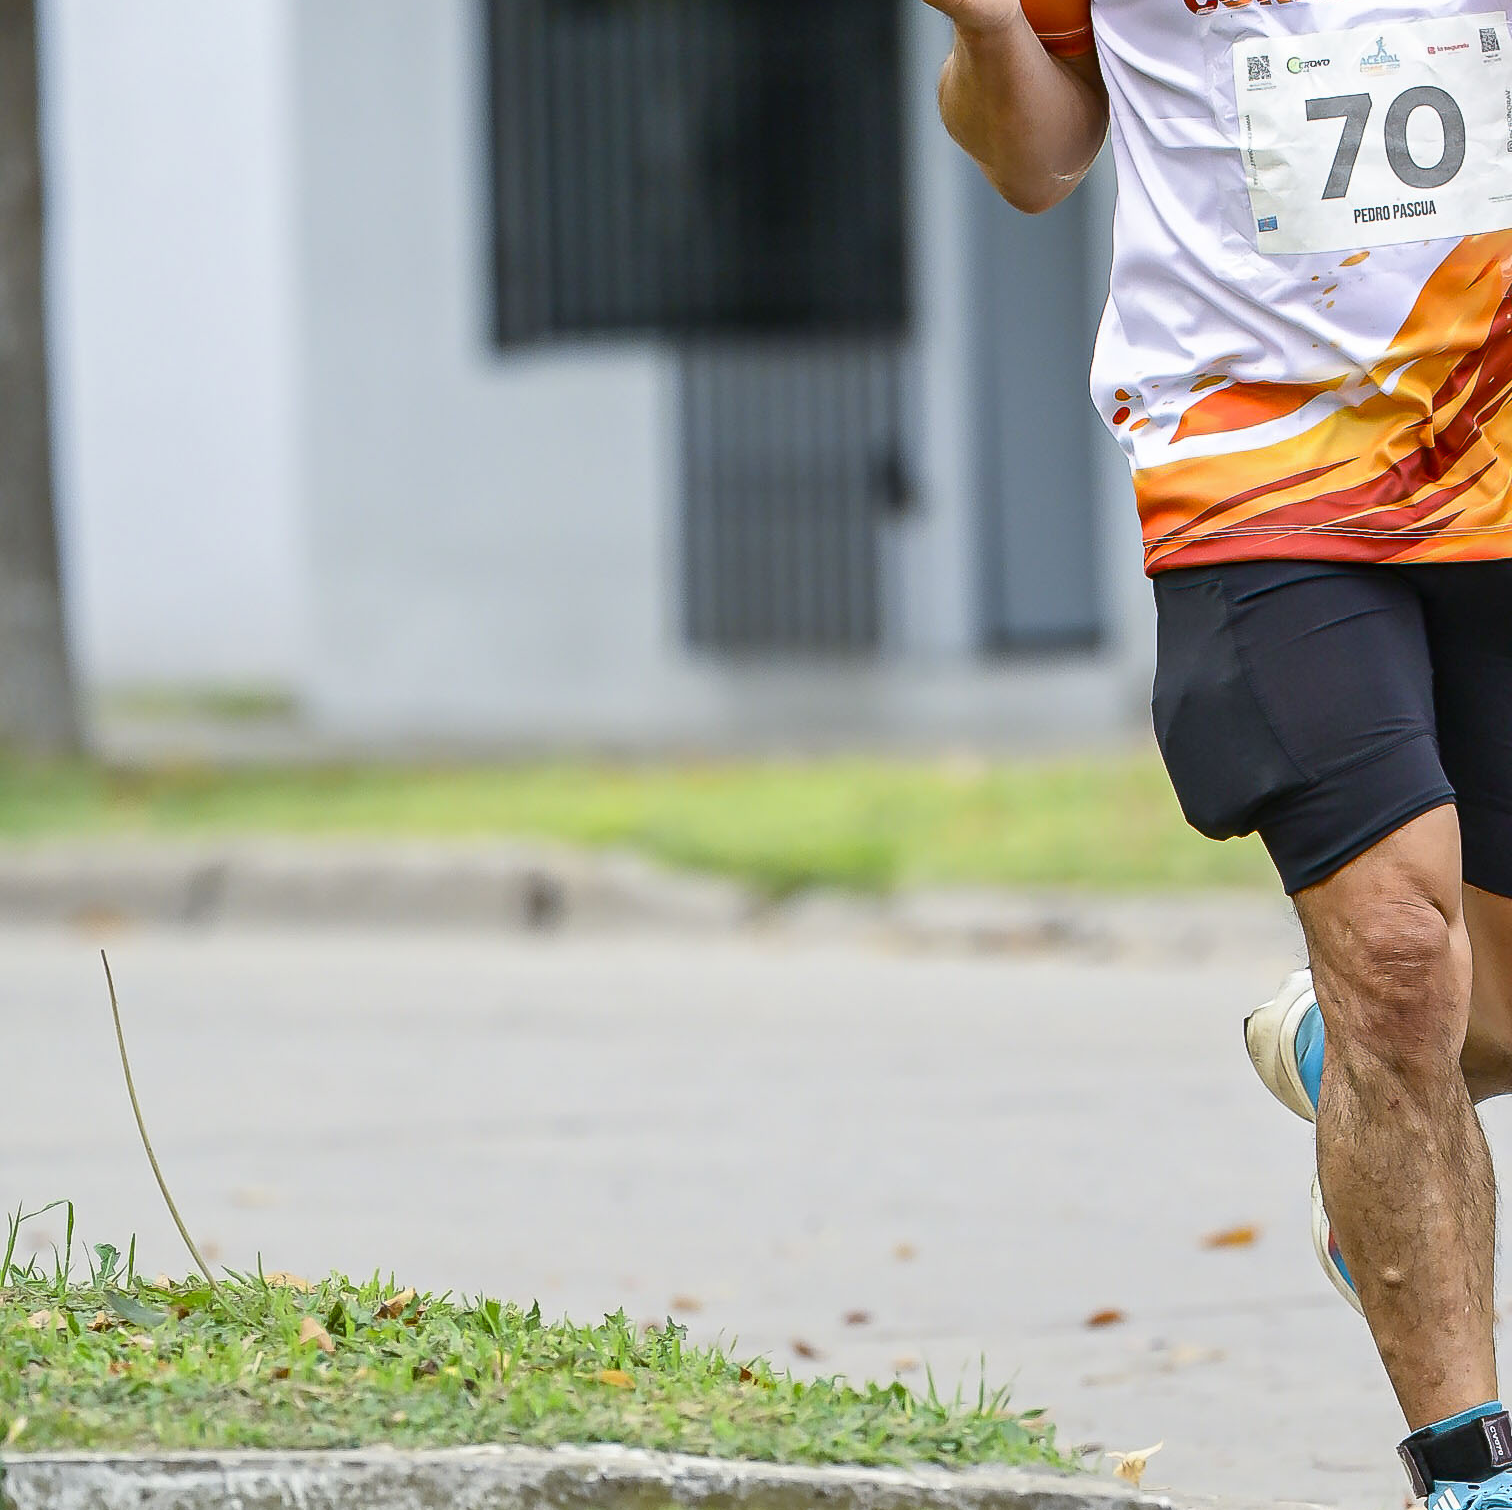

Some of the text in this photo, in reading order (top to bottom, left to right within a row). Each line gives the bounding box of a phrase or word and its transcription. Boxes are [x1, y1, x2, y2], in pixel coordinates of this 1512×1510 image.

[1305, 85, 1466, 200] 70
[1353, 200, 1437, 224] PEDRO PASCUA
